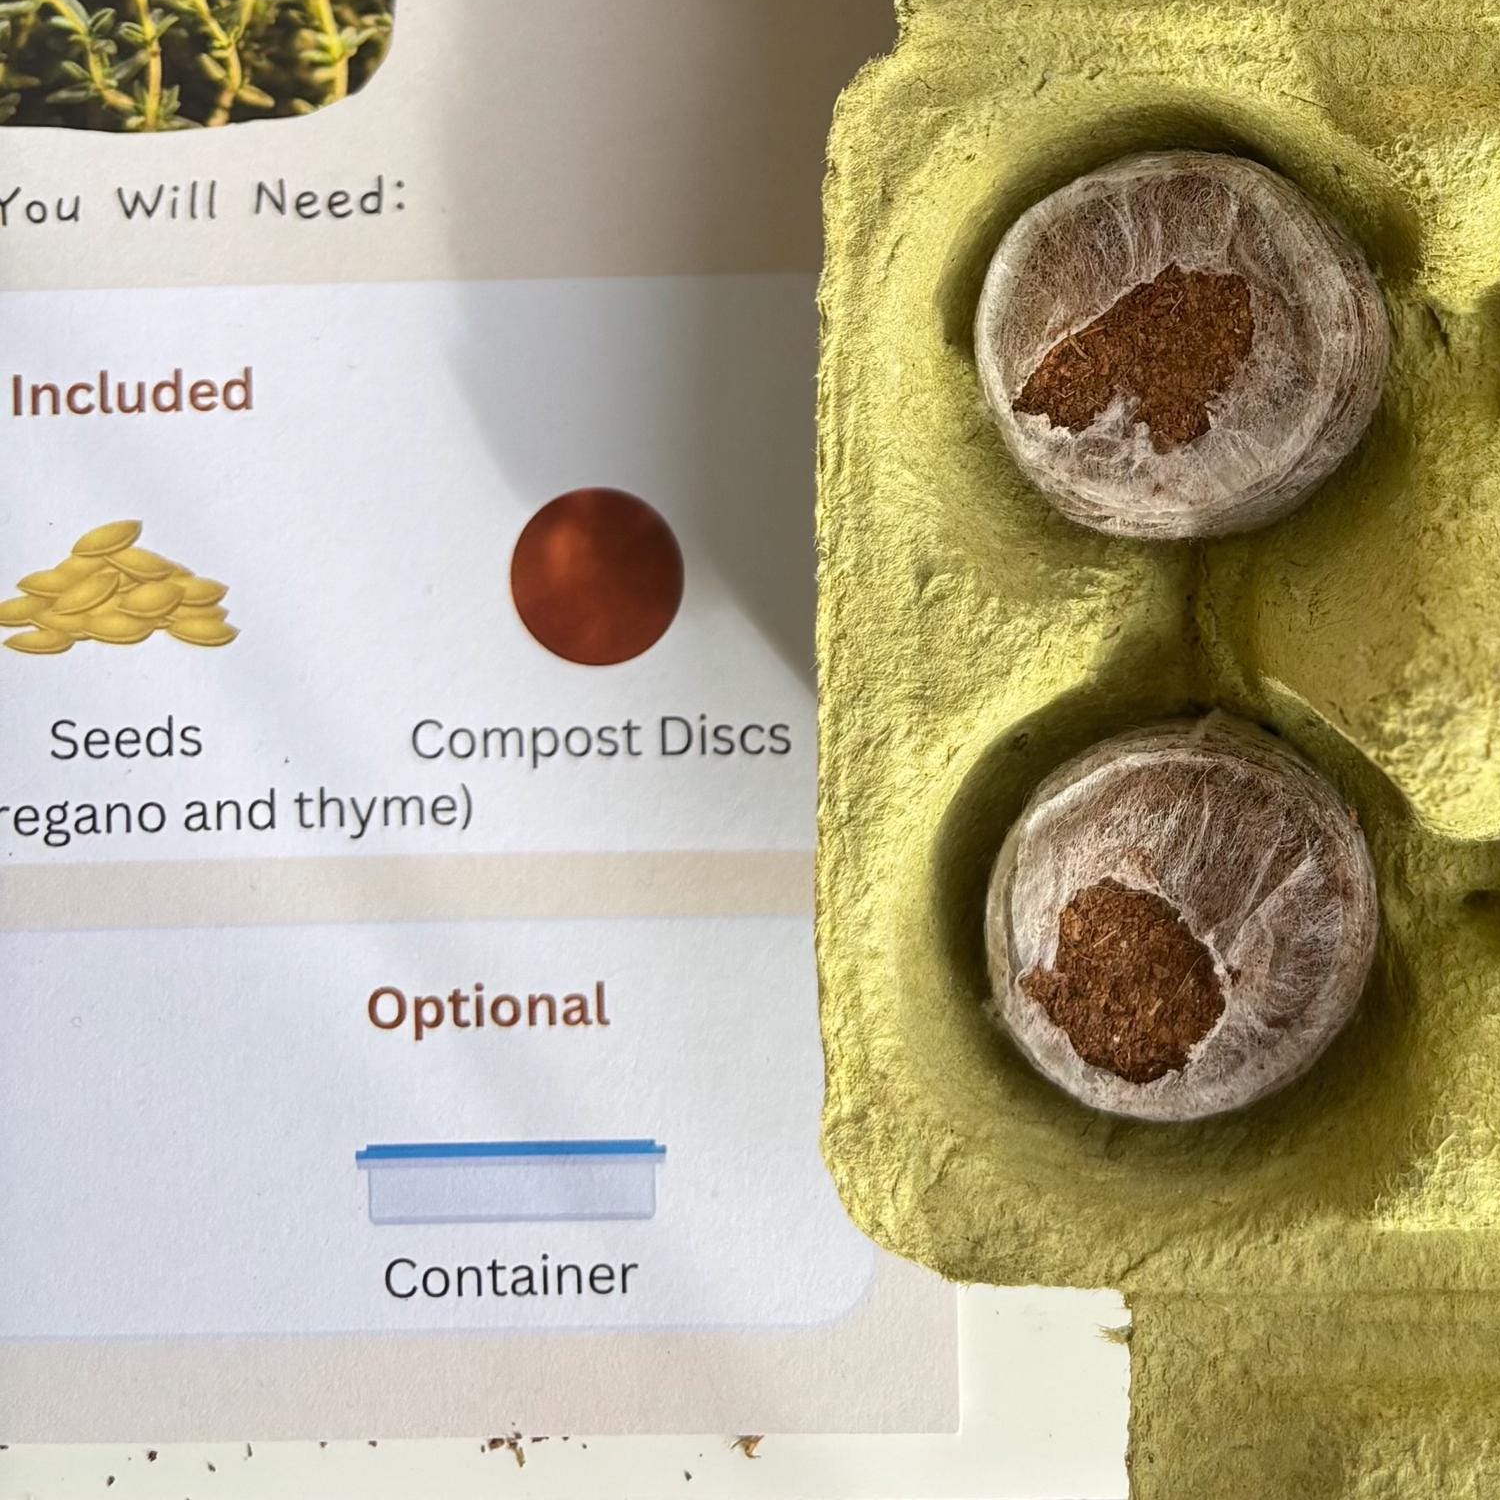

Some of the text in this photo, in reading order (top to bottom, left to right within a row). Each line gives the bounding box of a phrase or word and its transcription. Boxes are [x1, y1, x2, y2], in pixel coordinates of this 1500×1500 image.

[117, 180, 216, 219] Will
[254, 175, 404, 219] Need:
[13, 367, 252, 416] Included
[51, 715, 202, 760] Seeds
[412, 714, 791, 769] Compost Discs
[184, 788, 275, 832] and
[294, 784, 472, 839] thyme)
[368, 982, 610, 1041] Optional
[385, 1254, 638, 1298] Container
